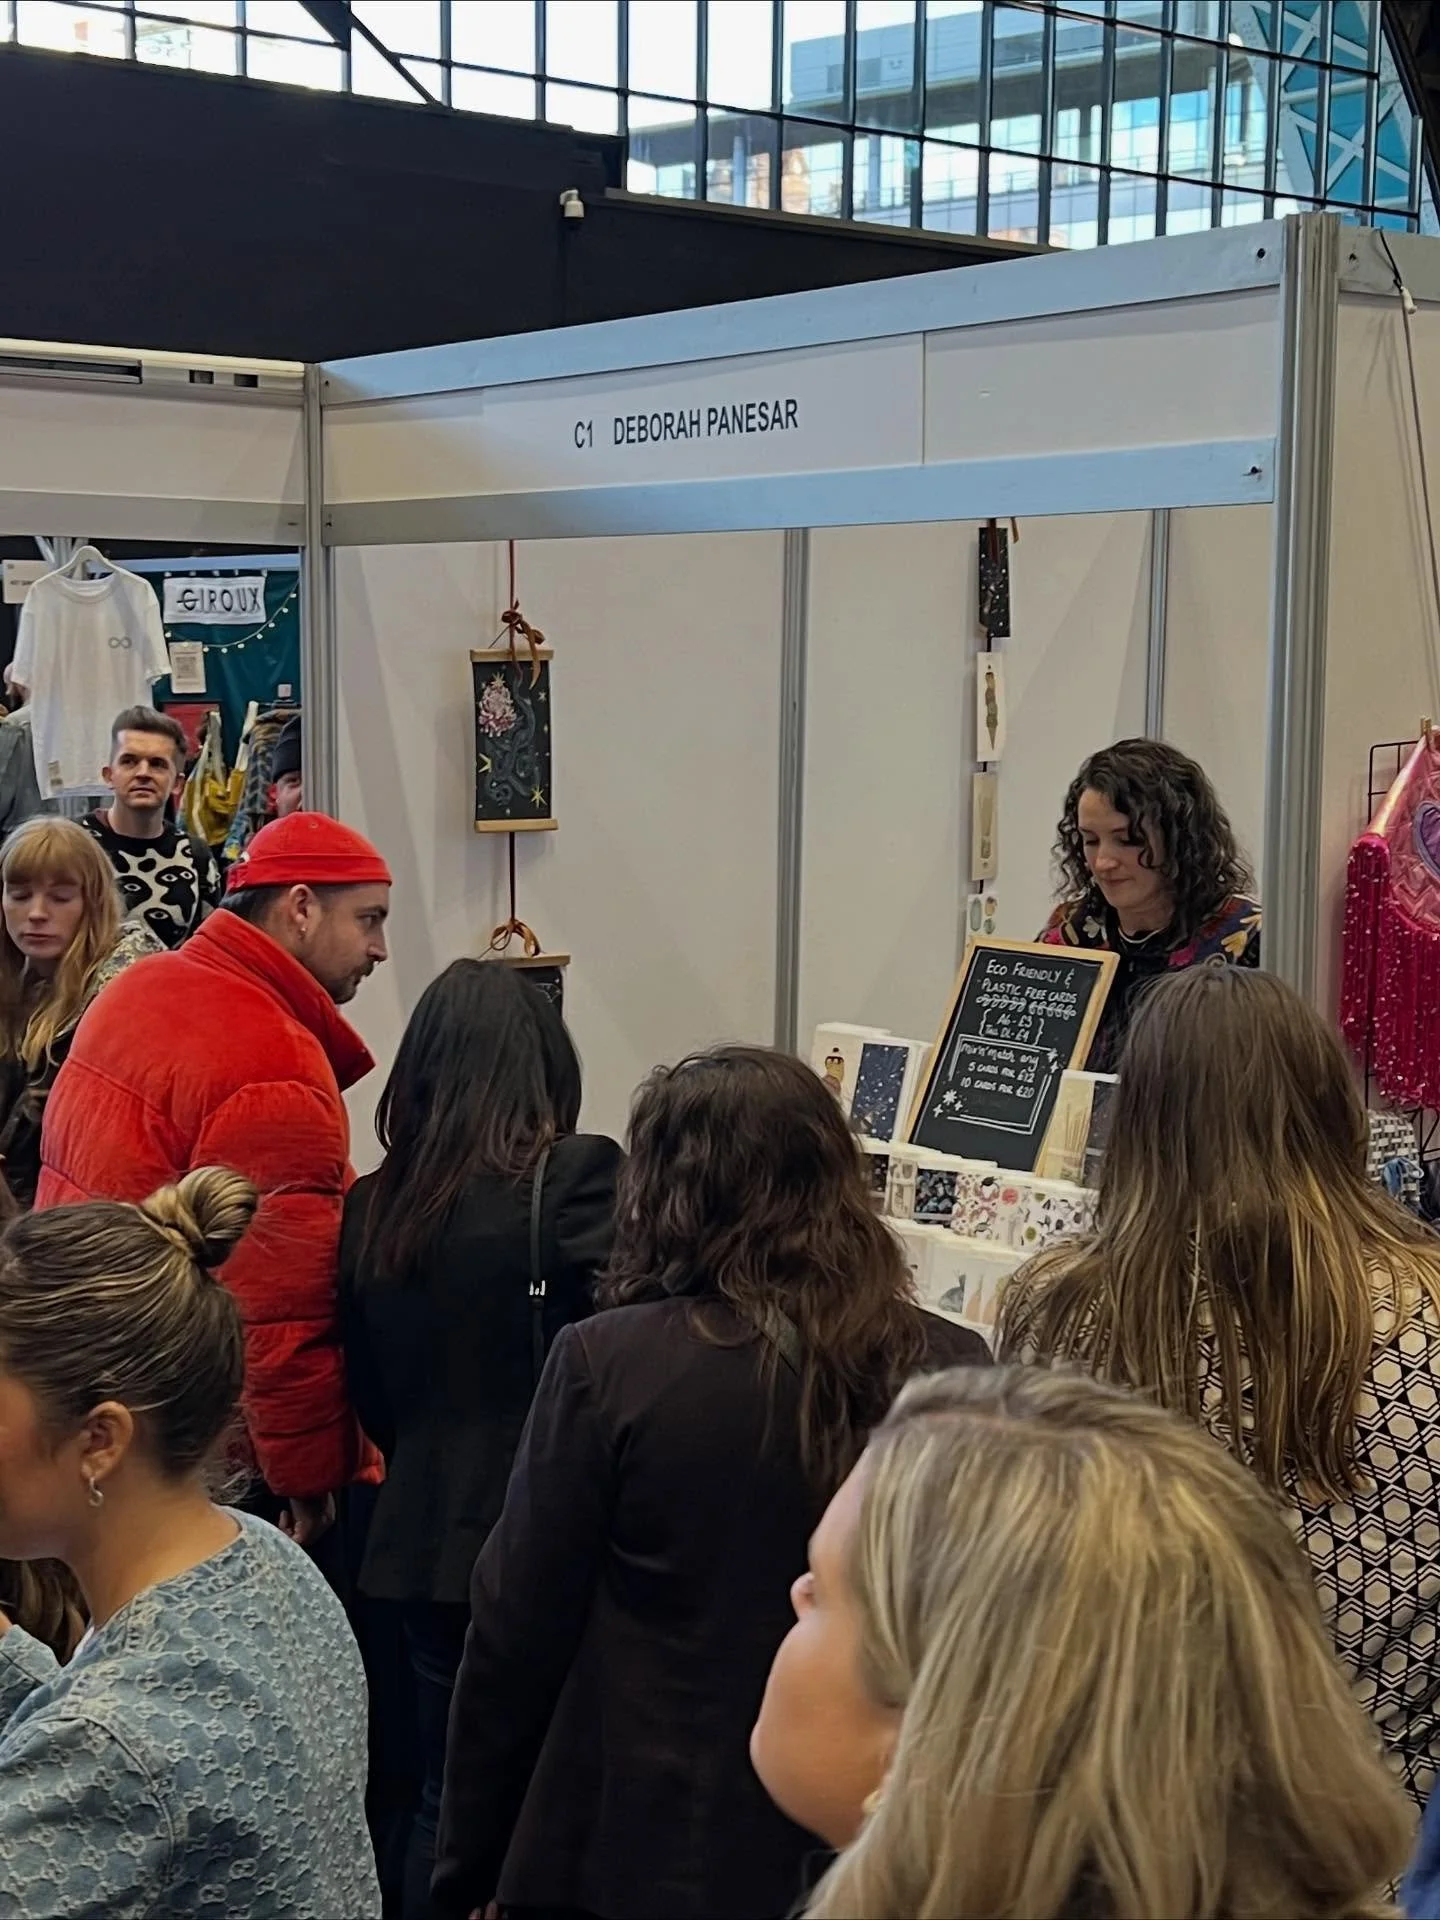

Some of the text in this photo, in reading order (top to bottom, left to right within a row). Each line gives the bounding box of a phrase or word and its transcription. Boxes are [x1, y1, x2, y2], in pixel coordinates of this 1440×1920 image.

[574, 398, 799, 448] C1 DEBORAH PANESAR
[176, 587, 261, 612] GIROUX
[981, 977, 1078, 1004] PLASTIC FREE CARDS
[968, 1061, 976, 1072] 5
[1017, 1069, 1035, 1083] £12
[1020, 1054, 1039, 1072] any
[960, 1077, 971, 1088] 10
[1015, 1085, 1035, 1099] £20
